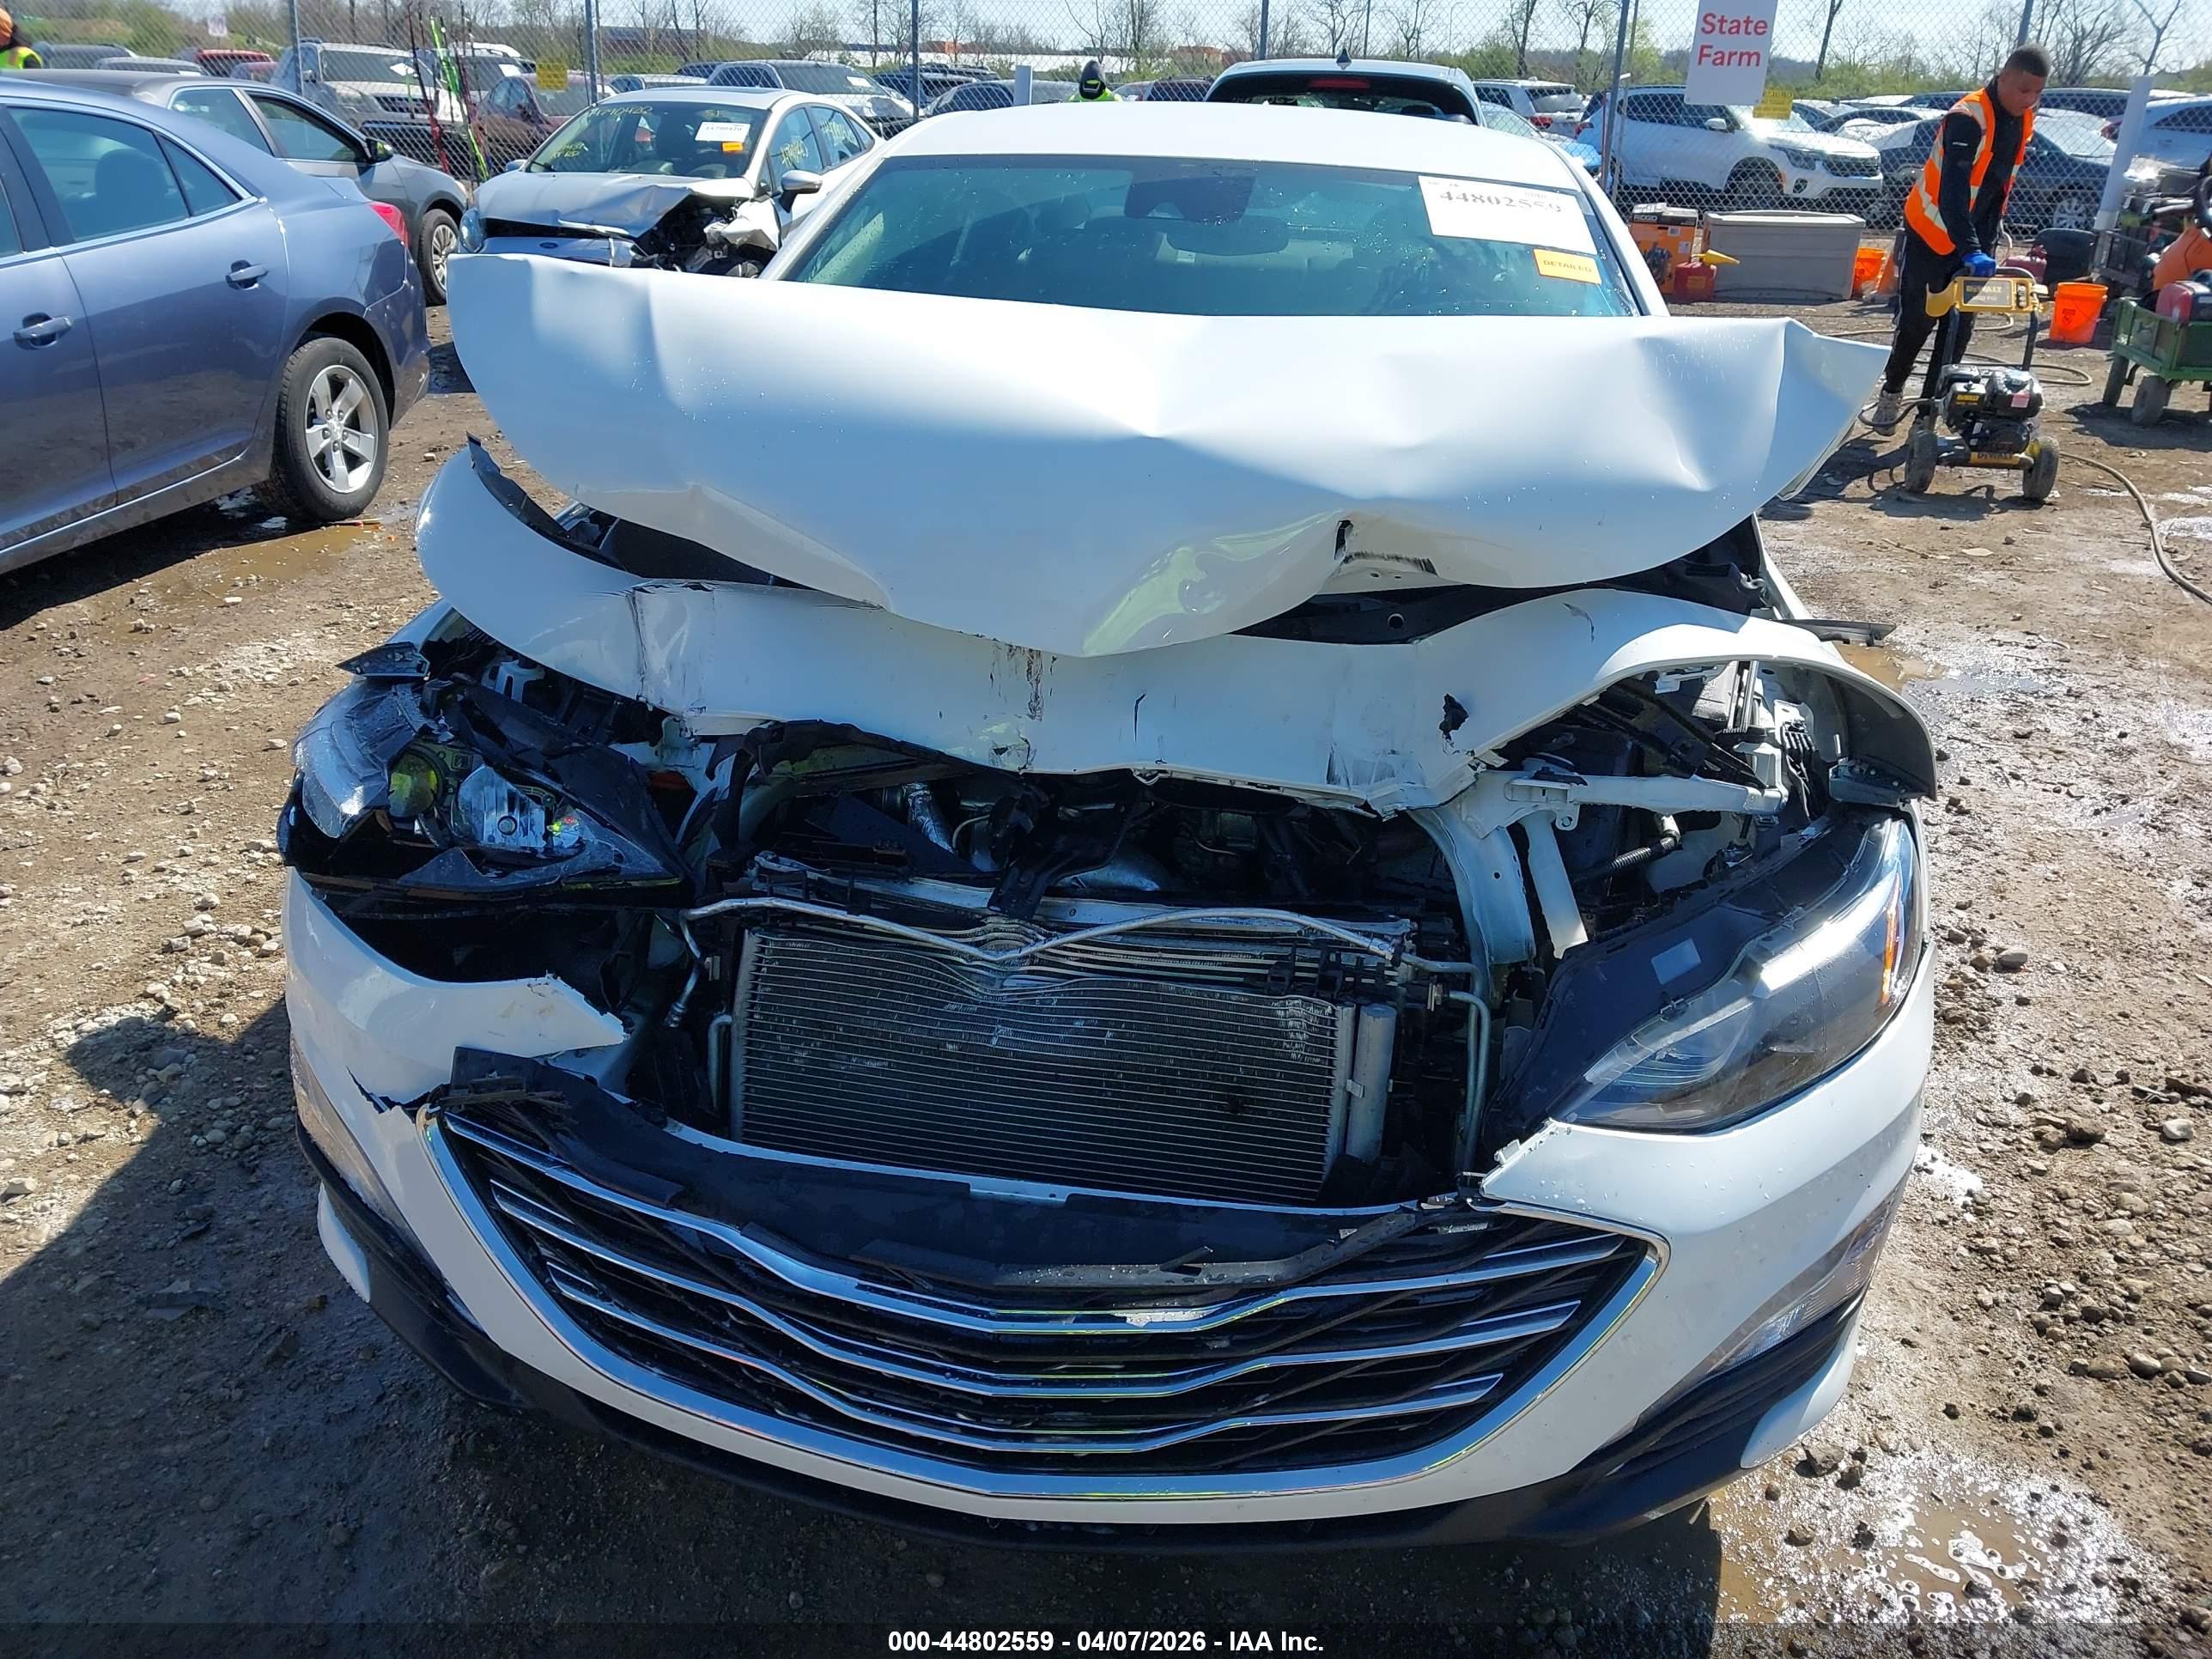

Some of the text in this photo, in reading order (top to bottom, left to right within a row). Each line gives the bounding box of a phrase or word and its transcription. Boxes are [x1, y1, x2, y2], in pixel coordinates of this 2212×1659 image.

[1701, 13, 1767, 35] State
[1698, 45, 1761, 66] Farm
[1543, 259, 1593, 273] DETAILED
